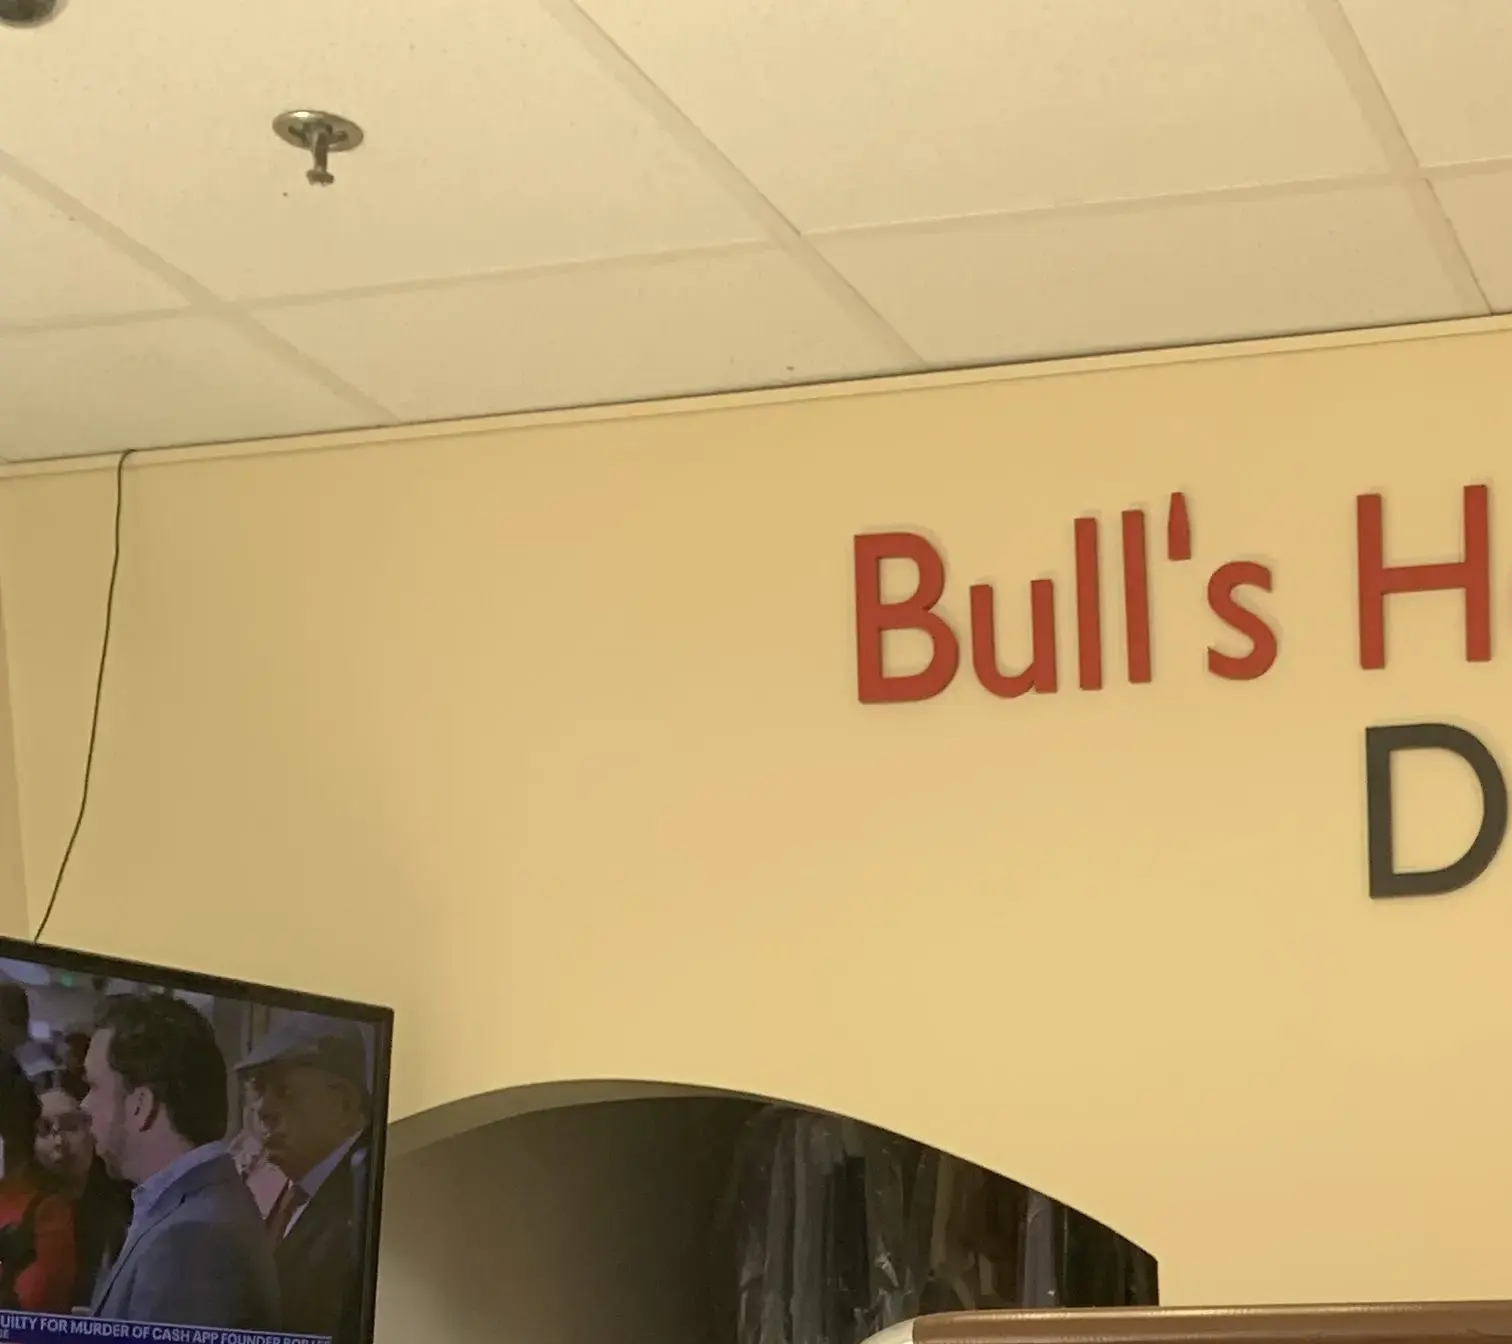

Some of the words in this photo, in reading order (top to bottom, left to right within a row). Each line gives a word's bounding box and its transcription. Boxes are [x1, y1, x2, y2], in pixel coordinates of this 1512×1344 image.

[853, 491, 1278, 704] Bull's
[0, 1315, 38, 1330] UILTY
[40, 1318, 68, 1333] FOR
[71, 1321, 129, 1338] MURDER
[132, 1326, 150, 1340] OF
[152, 1328, 190, 1343] CASH
[192, 1331, 219, 1344] APP
